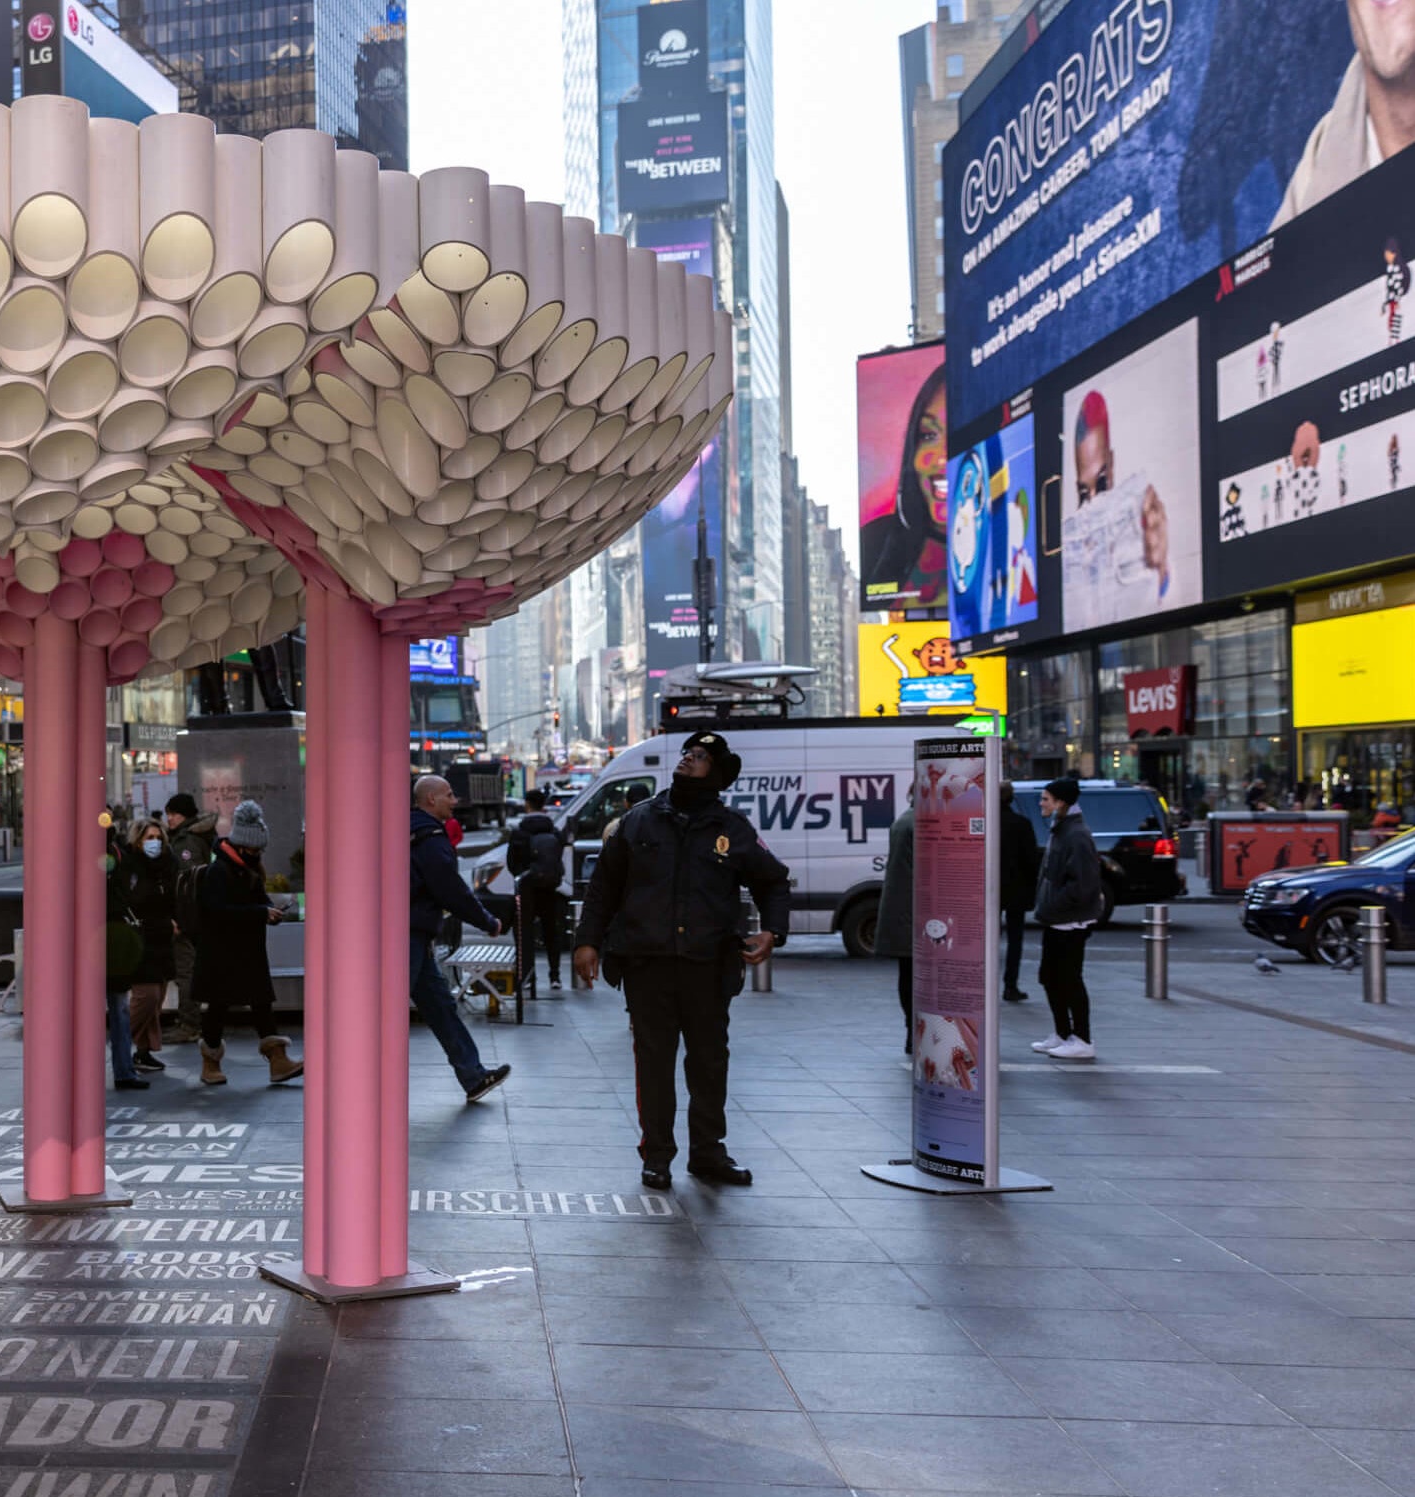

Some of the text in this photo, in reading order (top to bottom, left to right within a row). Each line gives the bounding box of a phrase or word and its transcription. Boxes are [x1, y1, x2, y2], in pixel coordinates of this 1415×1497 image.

[80, 20, 94, 47] LG
[29, 46, 53, 66] LG
[960, 0, 1173, 235] CONGRATS
[649, 156, 722, 180] BETWEEN
[992, 190, 1040, 250] AMAZING
[1090, 114, 1121, 160] TOM
[1121, 66, 1173, 133] BRADY
[1018, 259, 1051, 299] honor
[1050, 233, 1075, 274] and
[1075, 195, 1134, 261] pleasure
[1007, 288, 1059, 342] alongside
[1058, 273, 1082, 312] you
[1082, 258, 1098, 288] at
[1097, 206, 1161, 276] SiriusXM
[1339, 361, 1415, 413] SEPHORA
[846, 777, 890, 801] NY
[847, 804, 864, 842] 1
[409, 1190, 674, 1216] IRSCHFELD
[32, 1218, 300, 1243] IMPERIAL
[75, 1251, 295, 1265] BROOKS
[66, 1264, 263, 1279] ATKINSO
[30, 1290, 226, 1302] SAMUEL
[9, 1302, 281, 1326] FRIEDMAN
